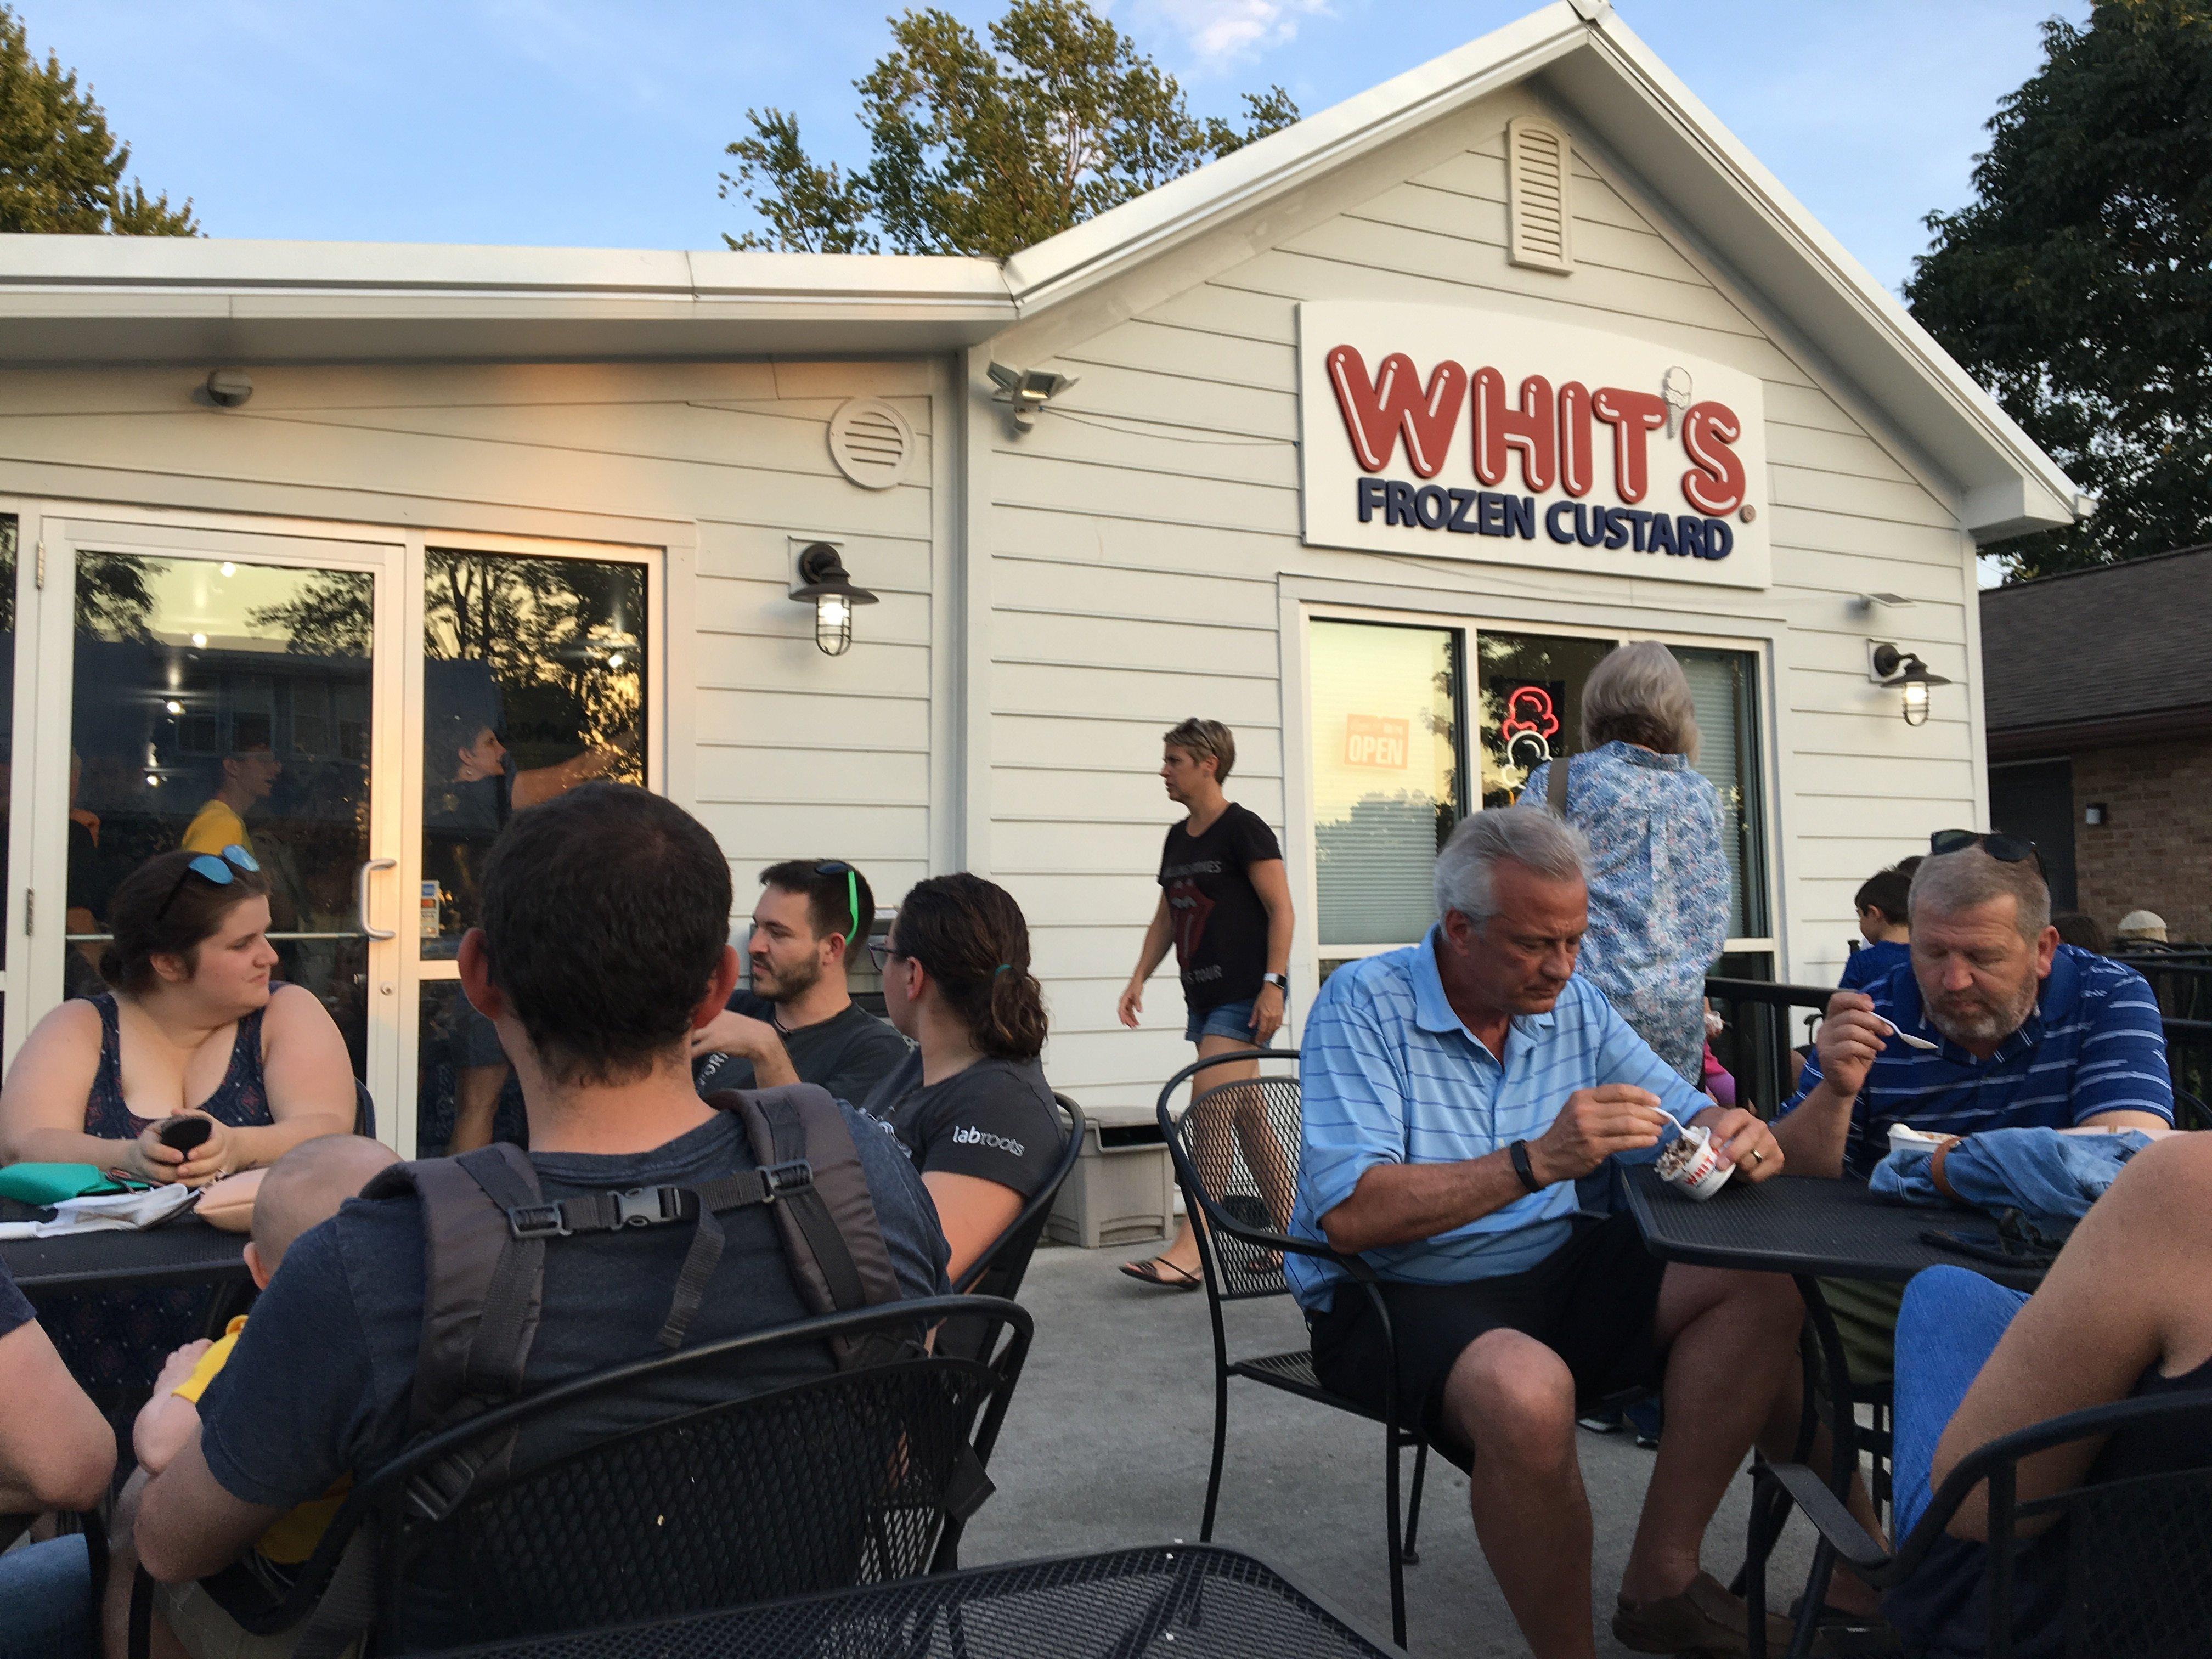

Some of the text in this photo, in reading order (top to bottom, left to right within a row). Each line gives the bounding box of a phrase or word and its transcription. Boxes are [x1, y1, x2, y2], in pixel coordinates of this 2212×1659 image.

[1358, 477, 1734, 561] FROZEN CUSTARD
[1350, 735, 1403, 765] OPEN
[952, 1125, 1025, 1157] labroots
